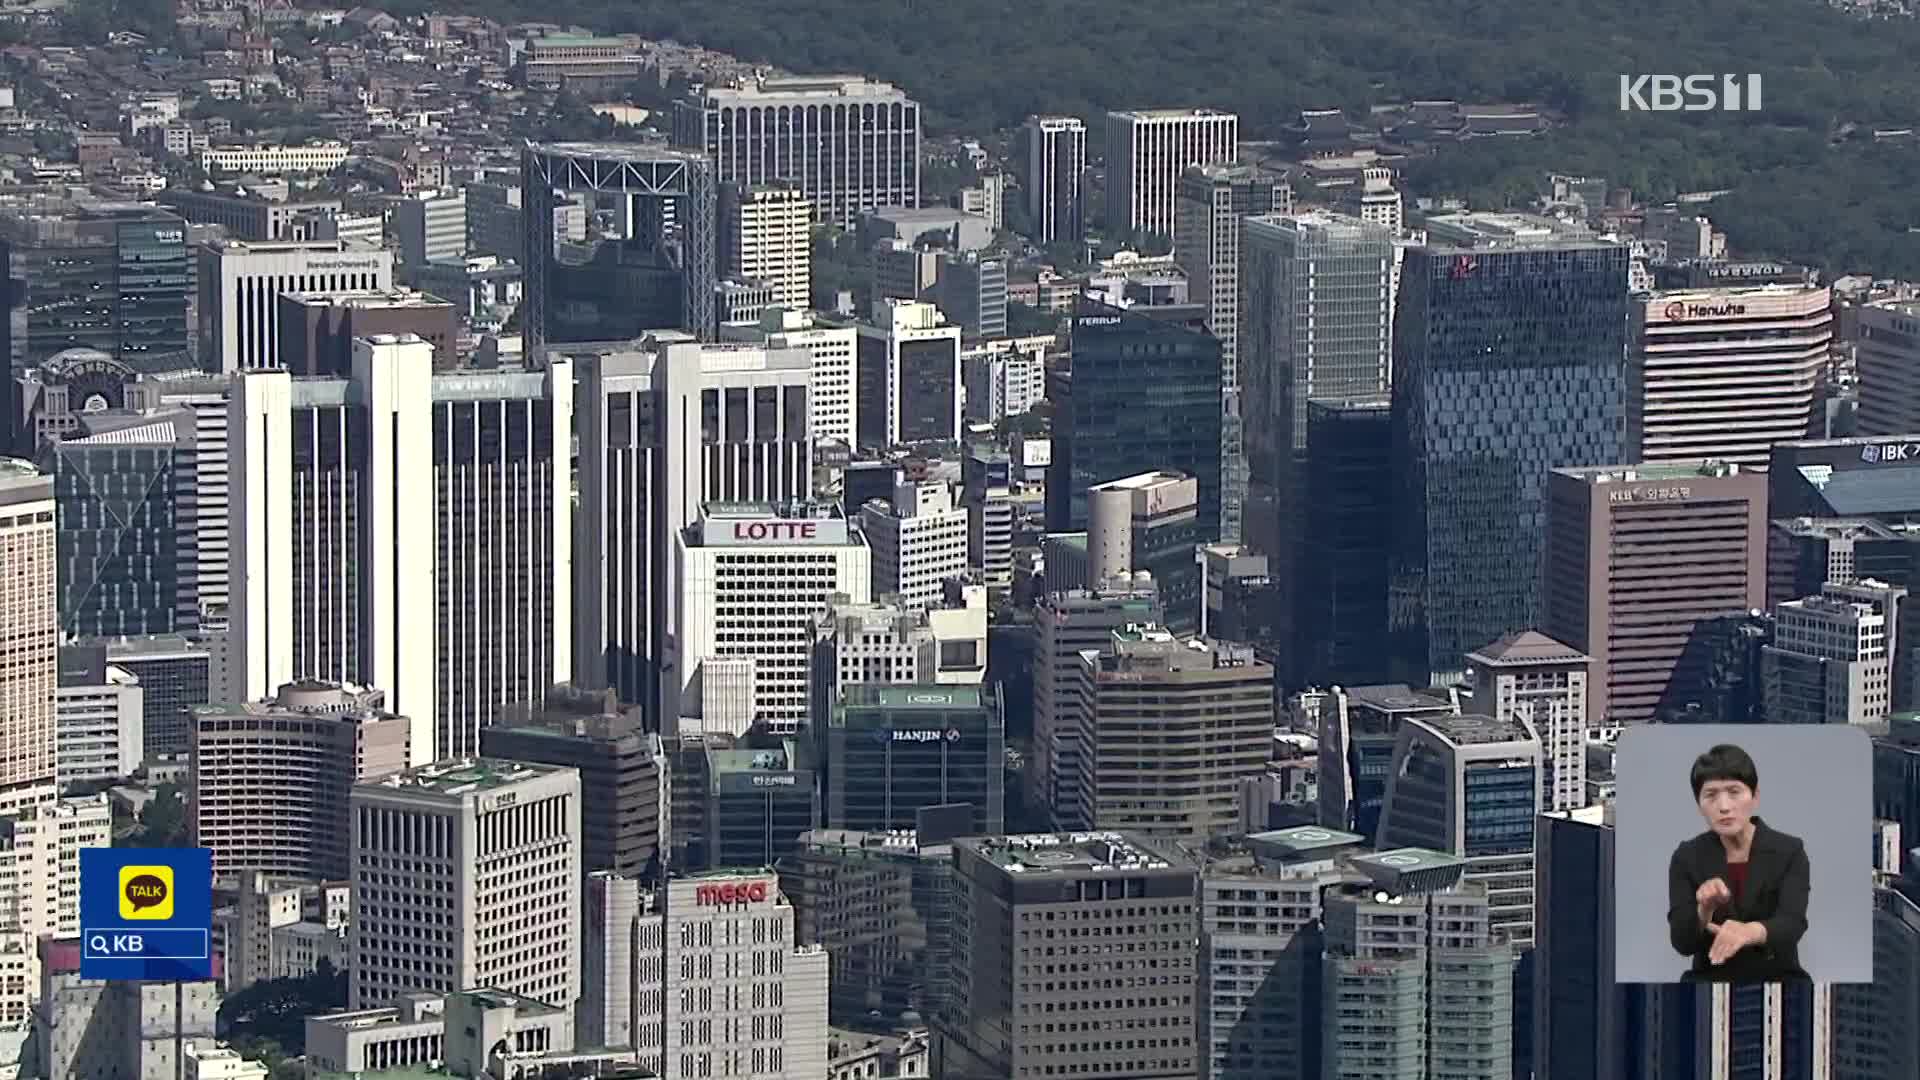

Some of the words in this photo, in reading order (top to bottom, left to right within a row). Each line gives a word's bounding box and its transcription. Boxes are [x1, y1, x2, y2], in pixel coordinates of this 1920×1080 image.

[1688, 303, 1745, 317] Hanwha
[1882, 444, 1908, 460] IBK
[735, 523, 816, 540] LOTTE
[893, 730, 941, 742] HANJIN
[696, 883, 767, 907] mesa
